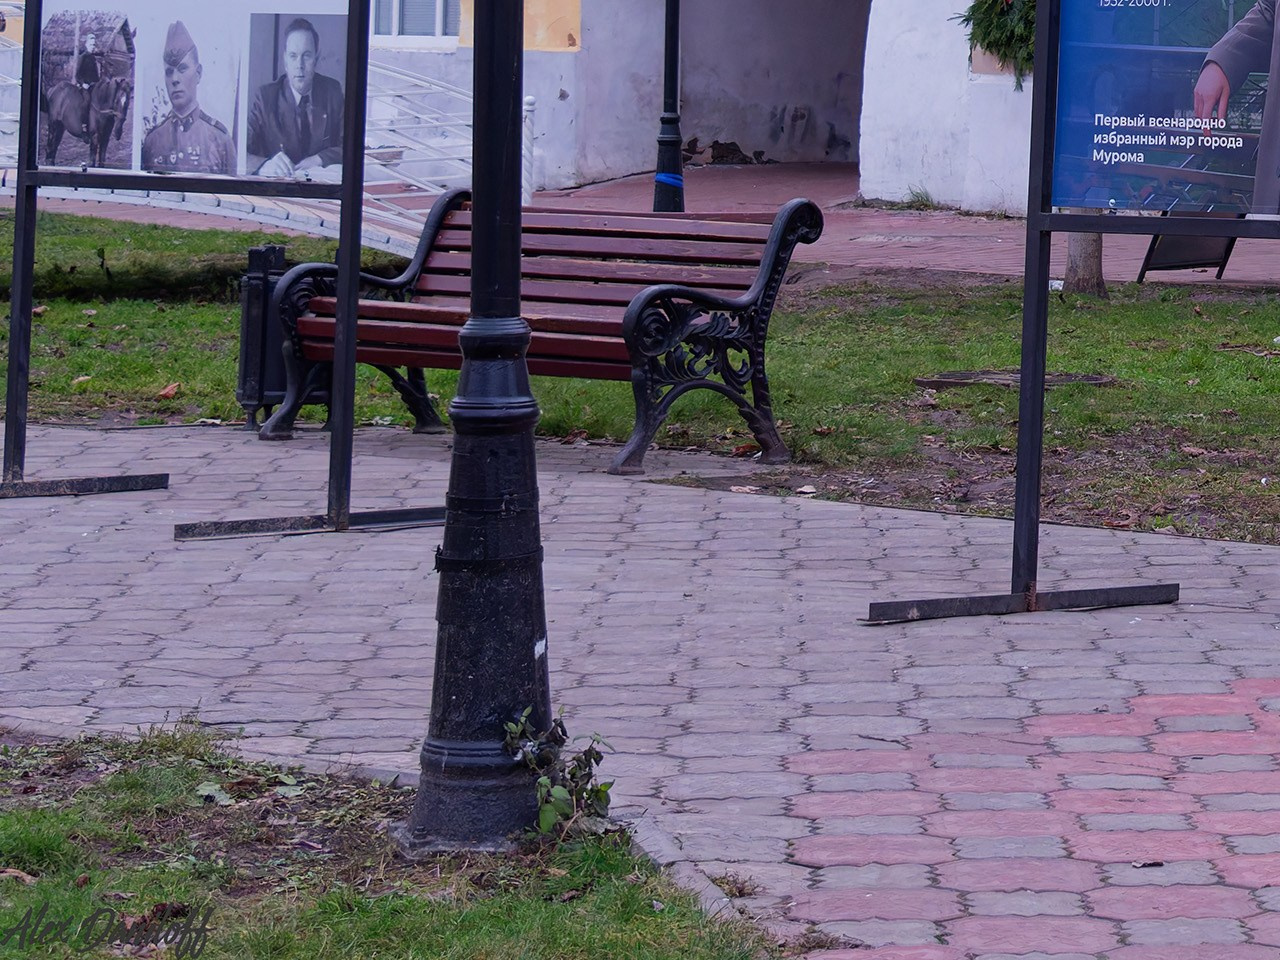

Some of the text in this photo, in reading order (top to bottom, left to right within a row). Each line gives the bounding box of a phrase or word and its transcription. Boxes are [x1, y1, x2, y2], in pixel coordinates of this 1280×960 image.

[1094, 113, 1226, 131] Первый всенародно
[1093, 131, 1243, 150] избранный мэр города
[1093, 149, 1145, 164] Мурома
